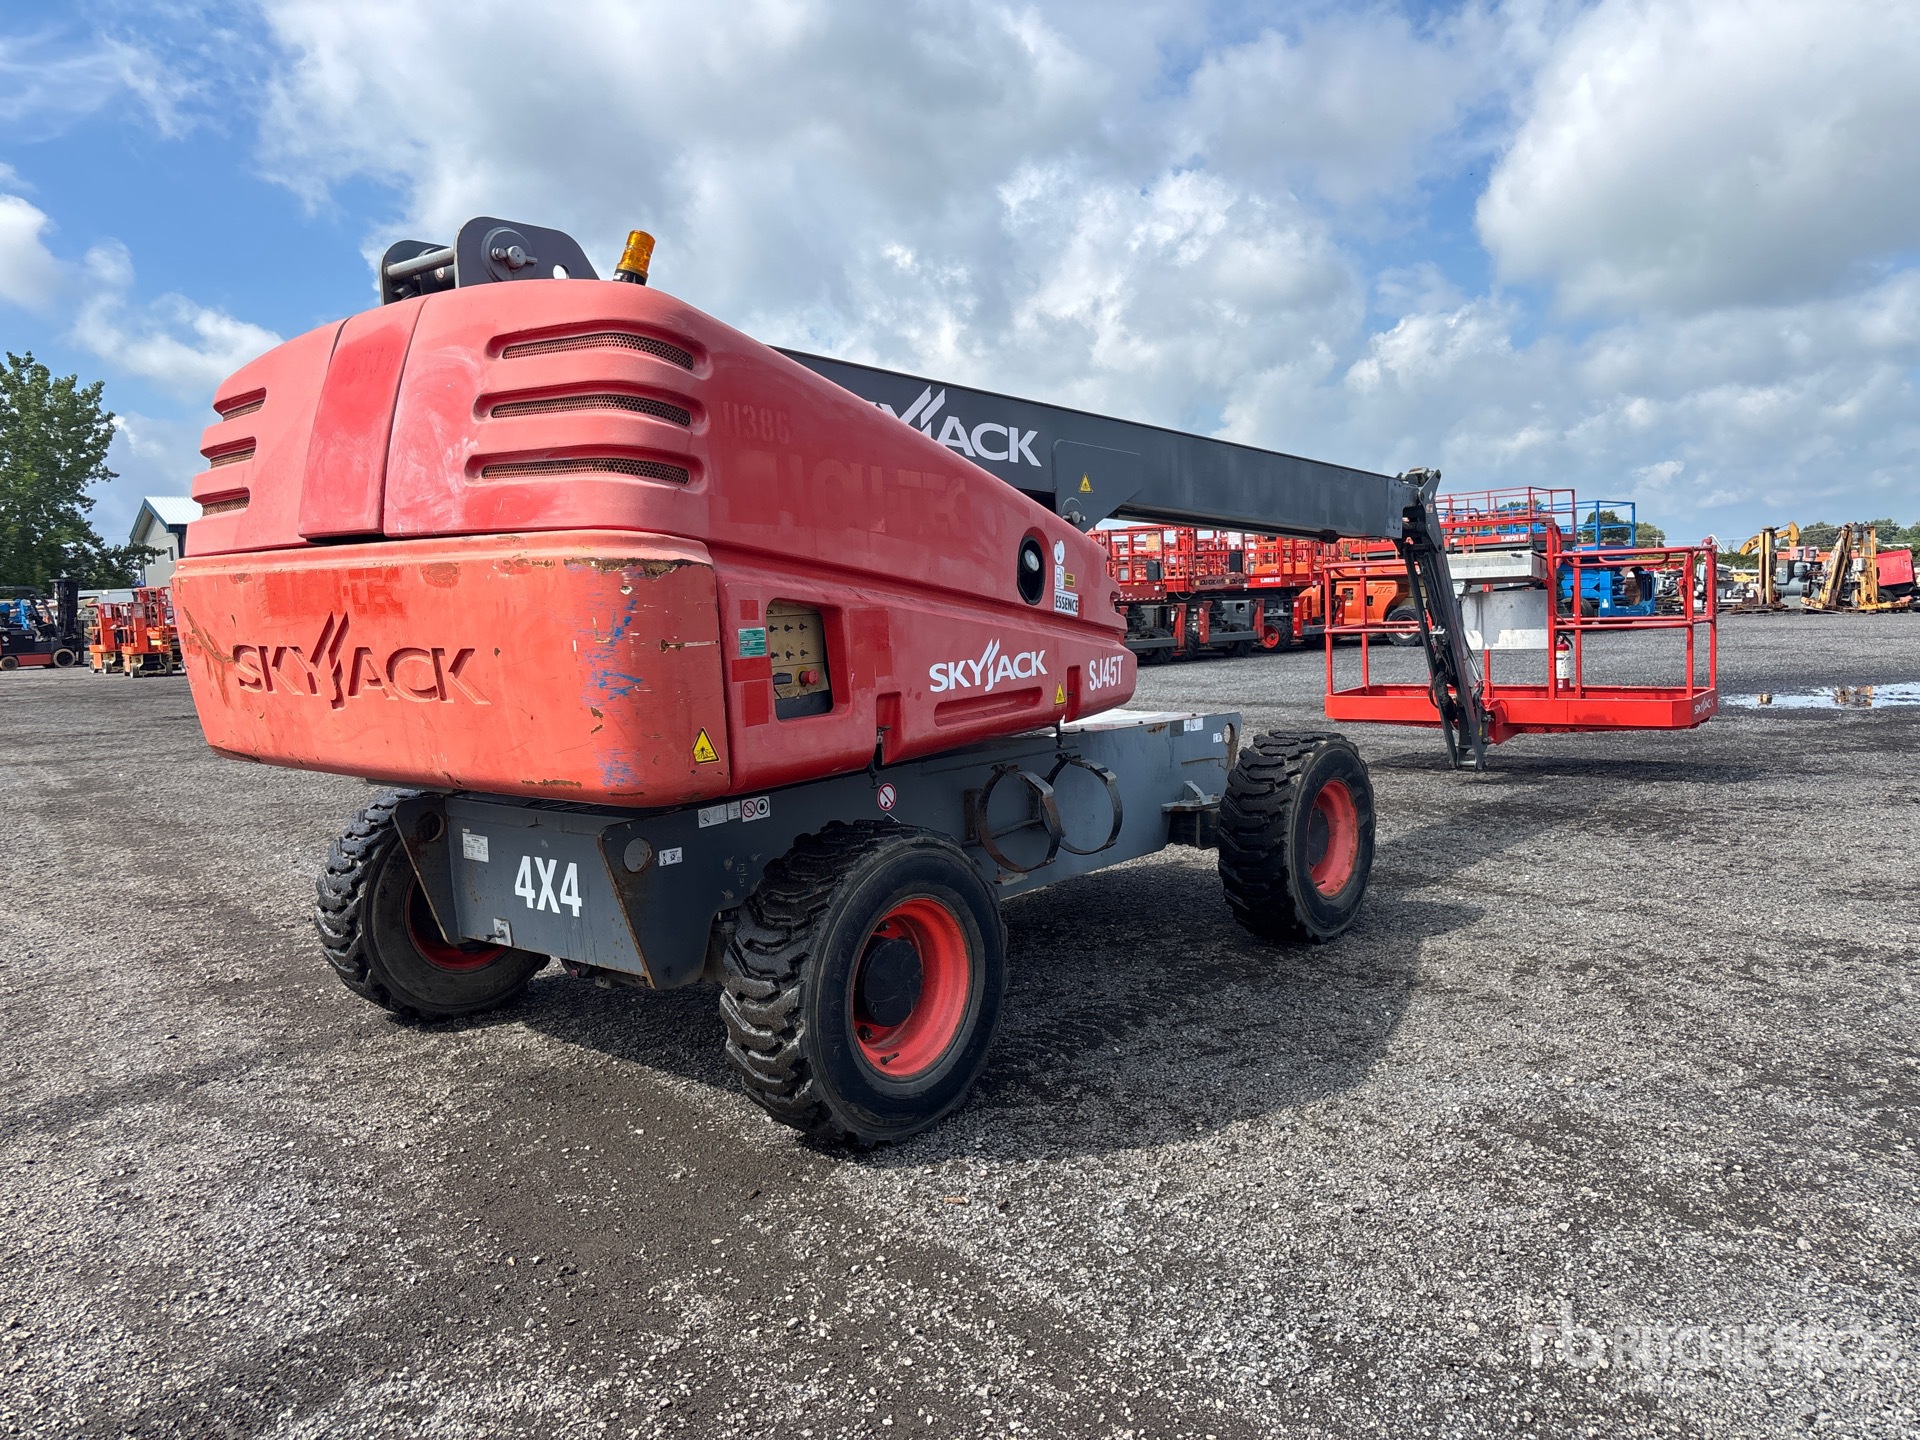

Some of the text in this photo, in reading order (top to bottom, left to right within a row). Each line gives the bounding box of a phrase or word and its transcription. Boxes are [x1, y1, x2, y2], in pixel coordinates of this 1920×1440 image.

[1055, 594, 1078, 613] ESSENCE
[232, 610, 492, 711] SKYJACK
[929, 638, 1048, 693] SKYJACK
[1088, 655, 1124, 691] SJ45T
[514, 855, 583, 918] 4X4
